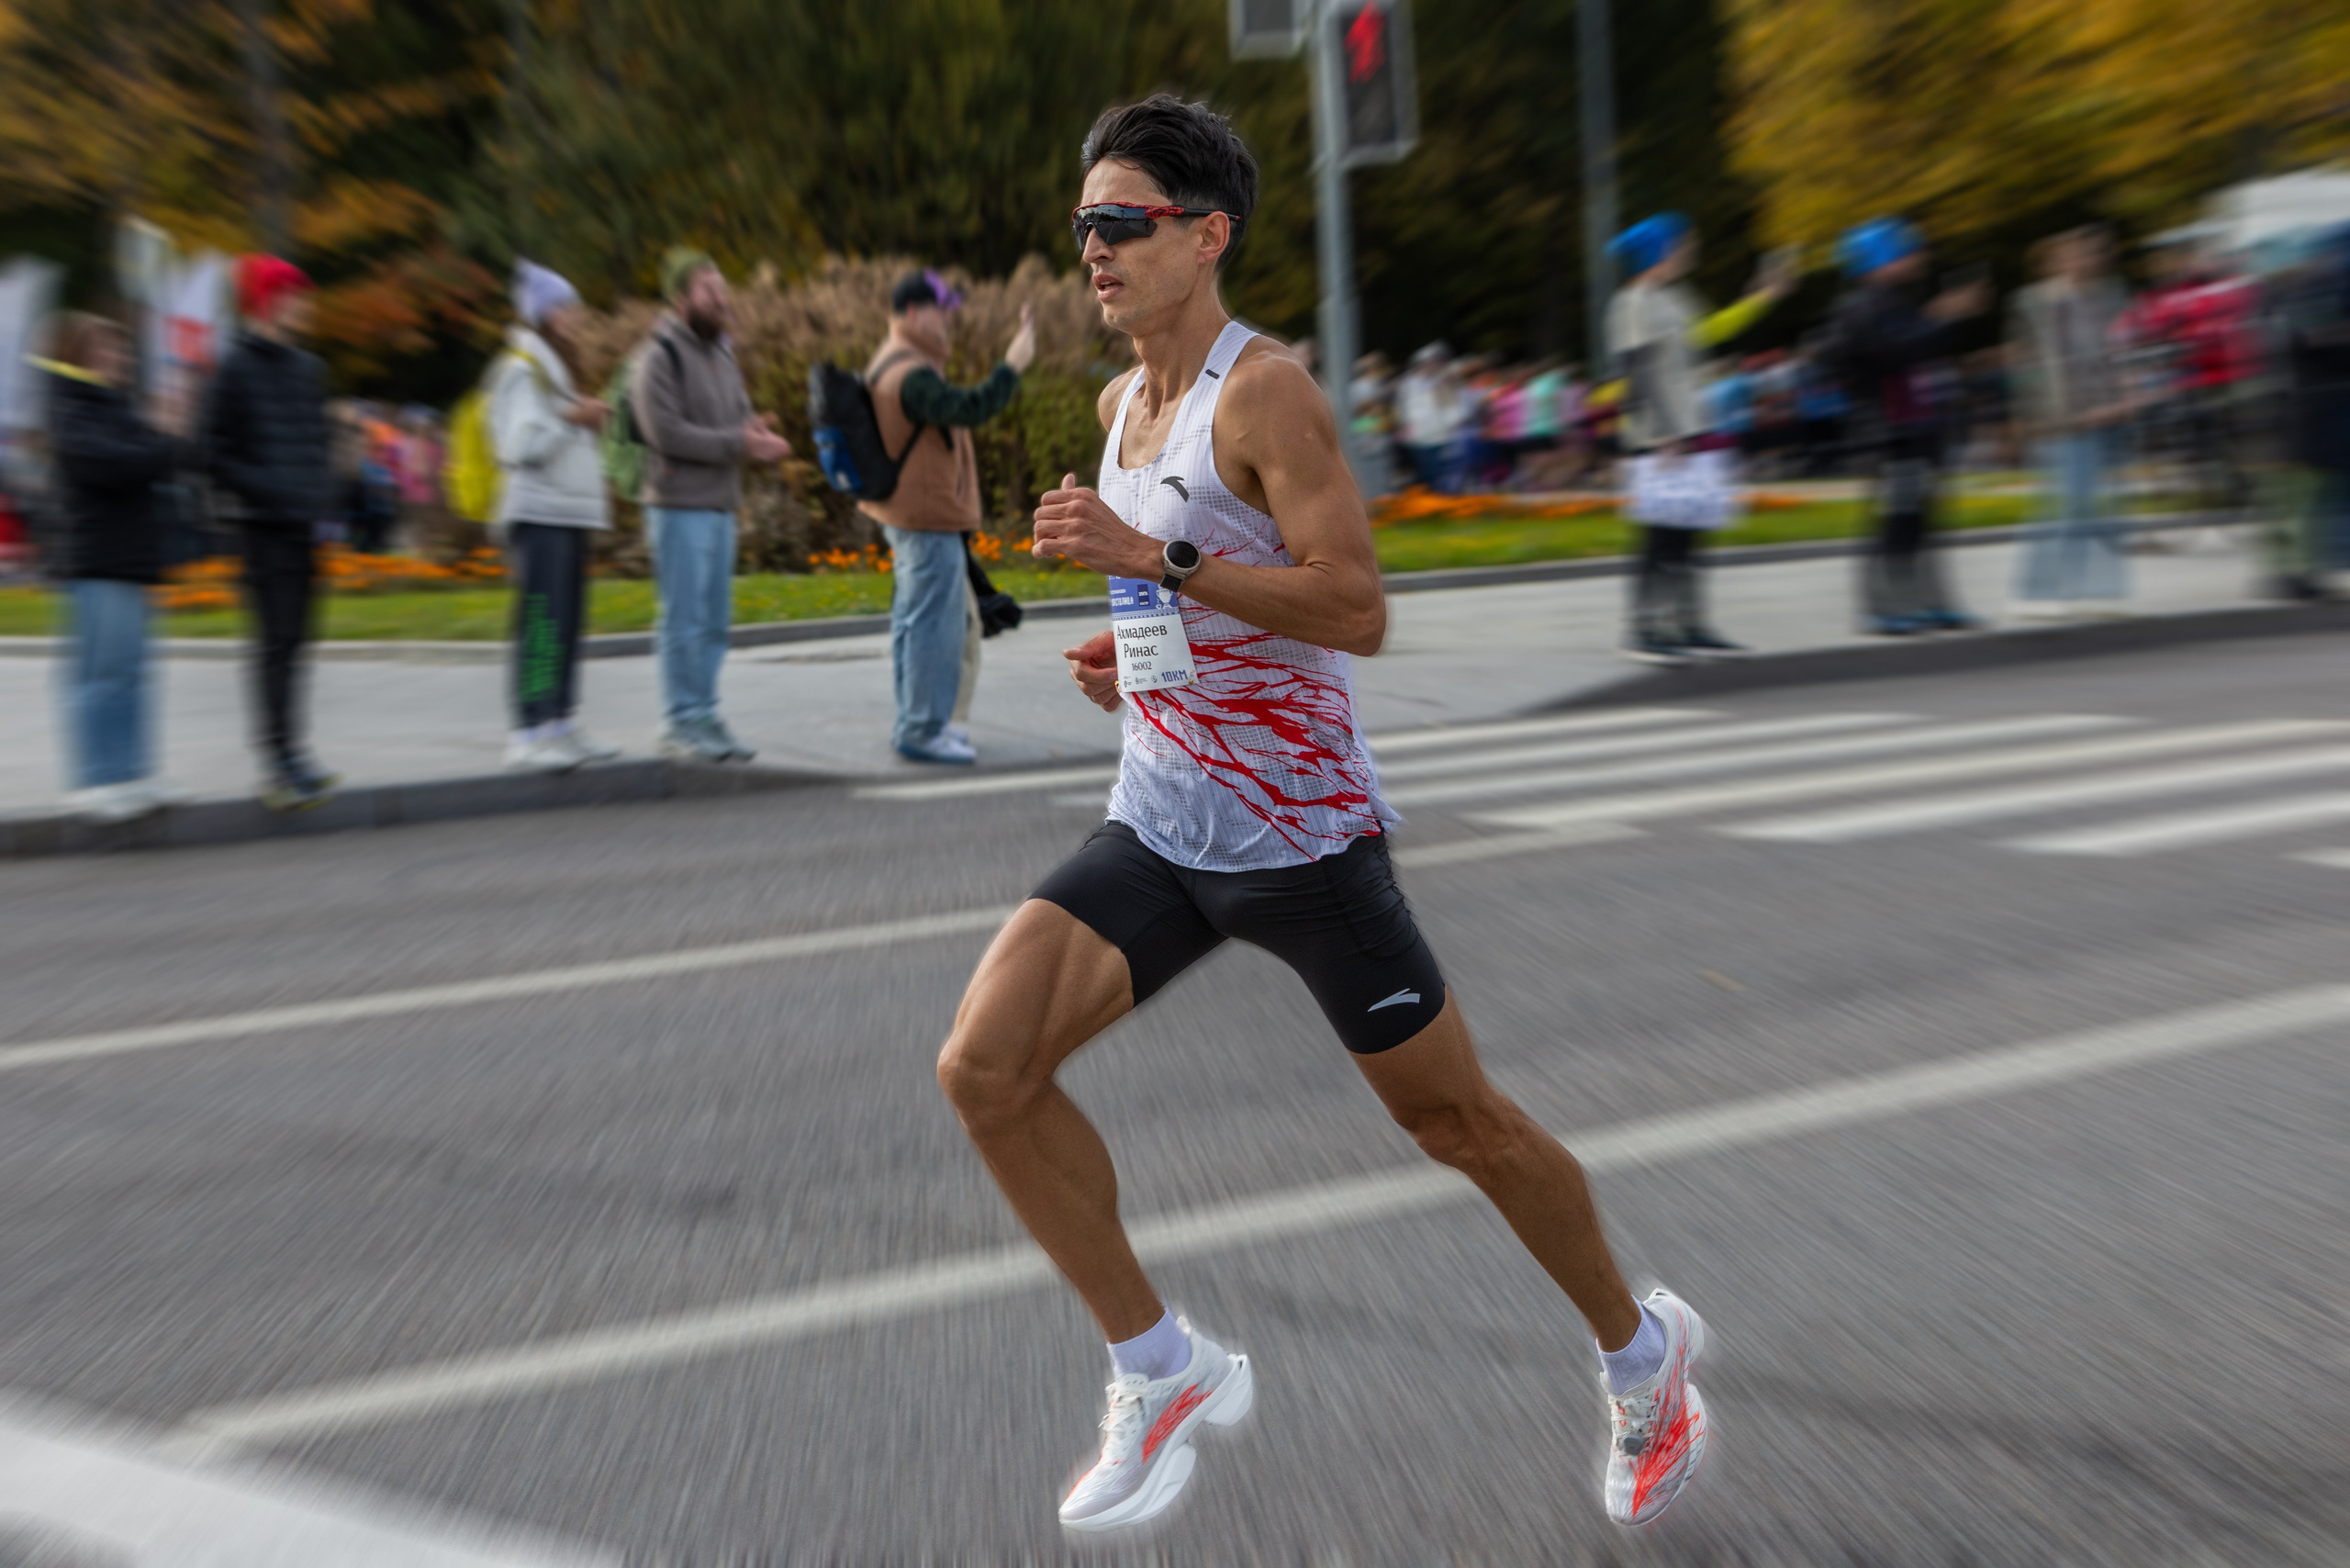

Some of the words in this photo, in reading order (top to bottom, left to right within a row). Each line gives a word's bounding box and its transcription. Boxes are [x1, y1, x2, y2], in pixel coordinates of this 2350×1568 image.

[1116, 624, 1168, 640] Ахмадеев
[1124, 643, 1158, 658] Ринас
[1131, 661, 1152, 671] 16002
[1161, 669, 1188, 682] 10КМ
